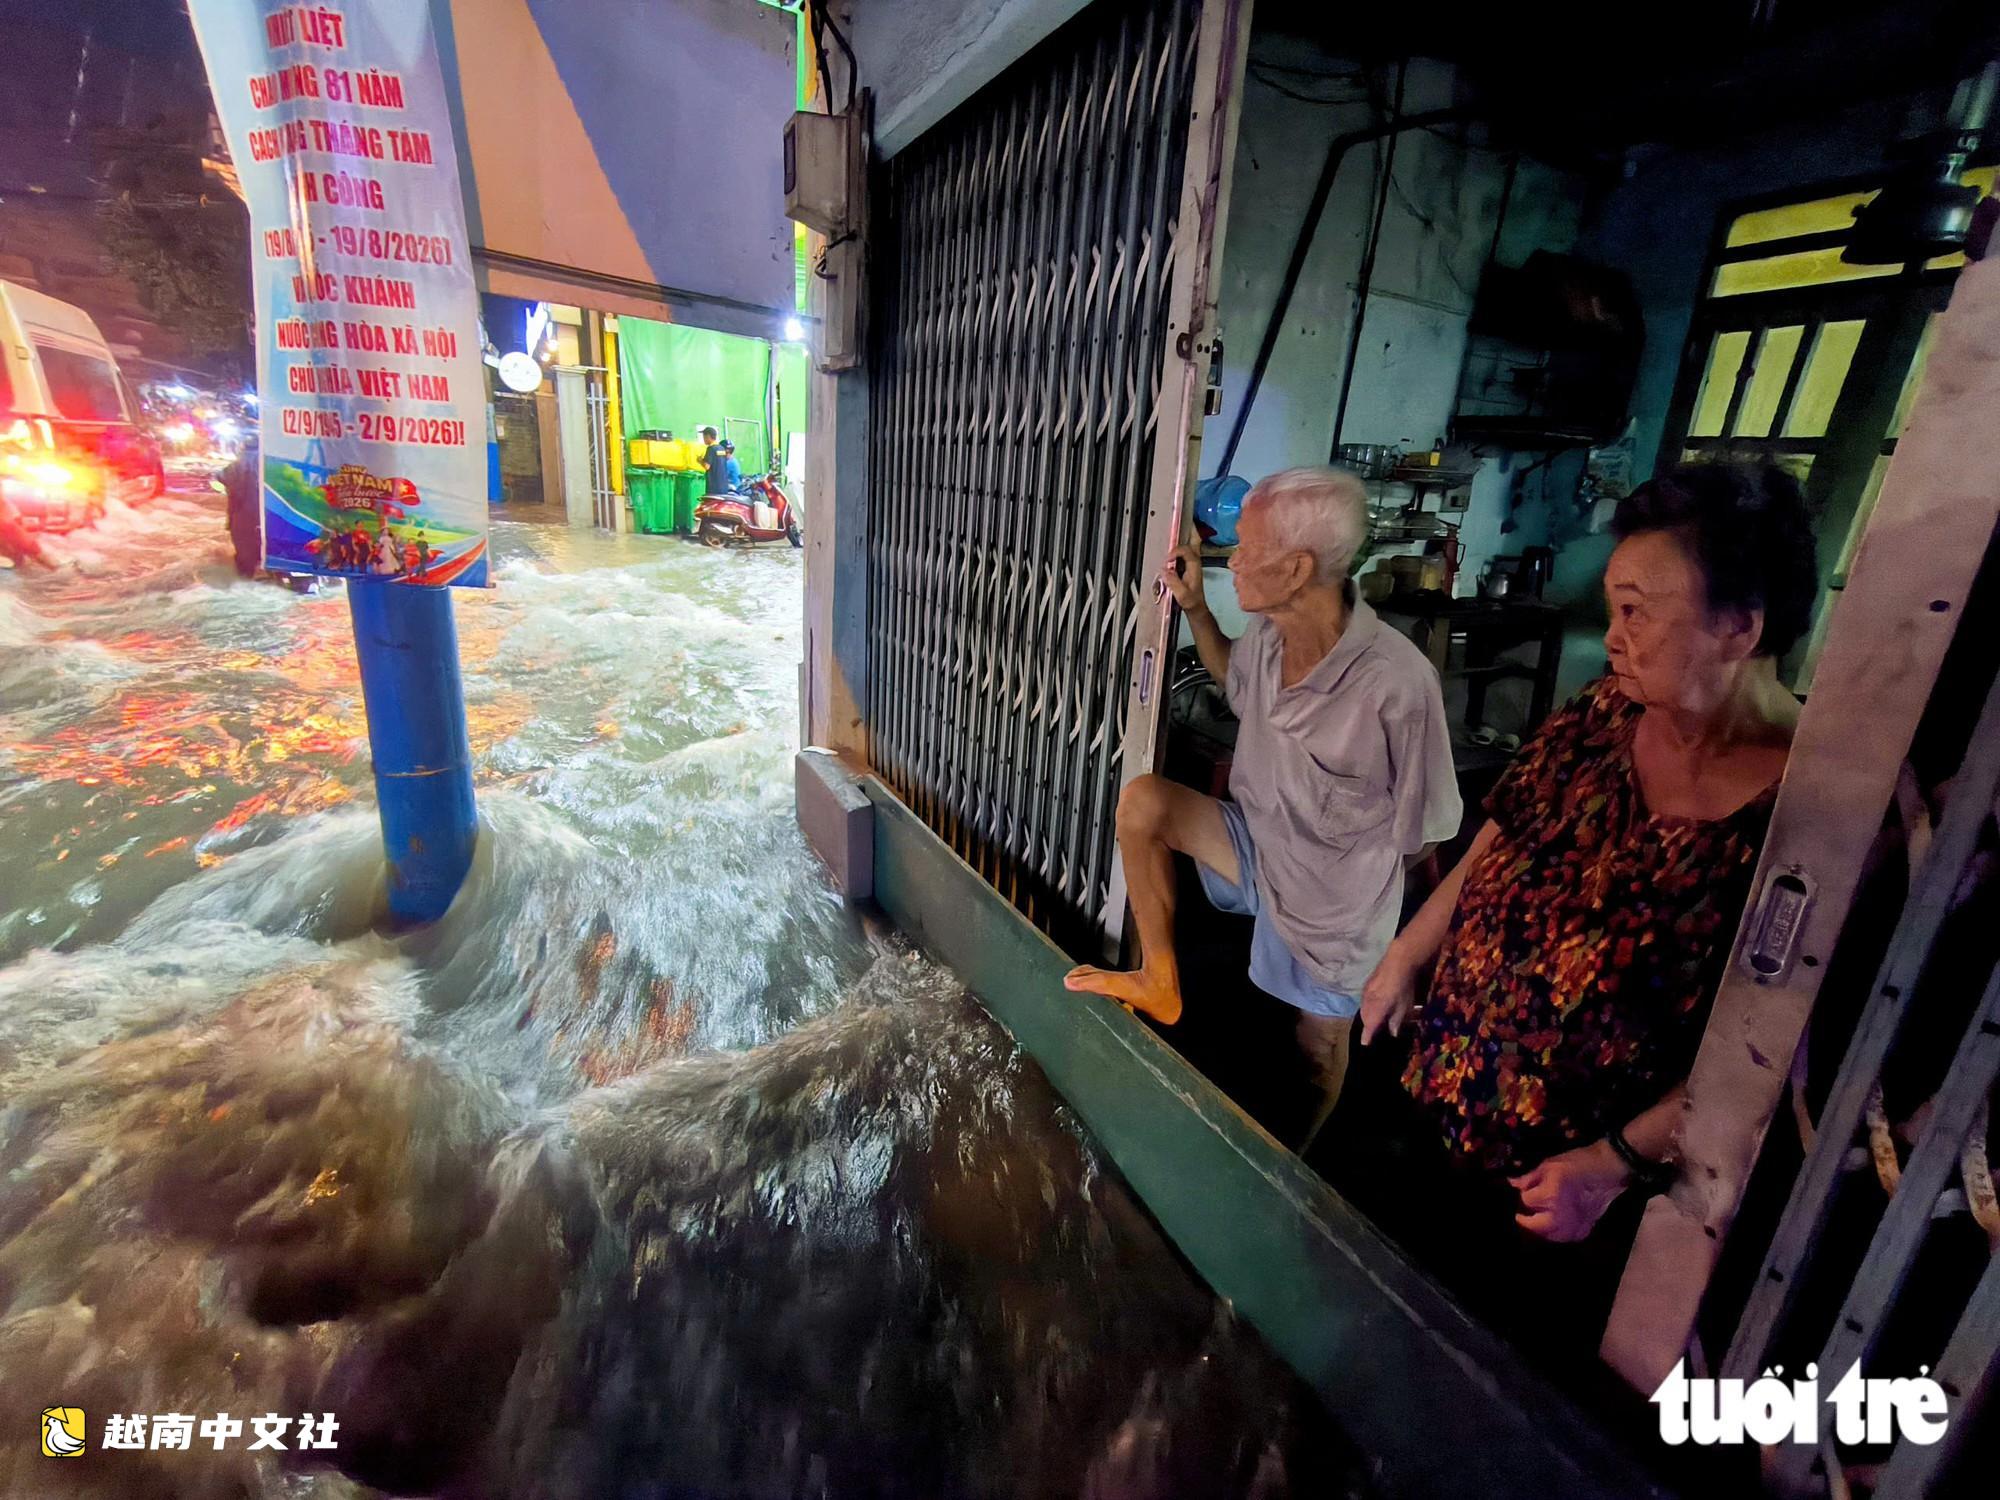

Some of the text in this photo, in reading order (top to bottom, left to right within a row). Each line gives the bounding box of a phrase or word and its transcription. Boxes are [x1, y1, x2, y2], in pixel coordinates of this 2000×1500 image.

[298, 6, 343, 52] LIỆT
[324, 68, 352, 103] 81
[356, 67, 405, 108] NĂM
[309, 120, 384, 160] THÁNG
[388, 126, 432, 164] TÁM
[323, 171, 385, 210] CÔNG
[344, 273, 416, 309] KHÁNH
[344, 319, 389, 353] HÒA
[391, 324, 419, 355] XÃ
[422, 326, 457, 362] HỘI
[289, 361, 315, 393] CHỦ
[356, 367, 401, 402] VIỆT
[407, 374, 450, 402] NAM
